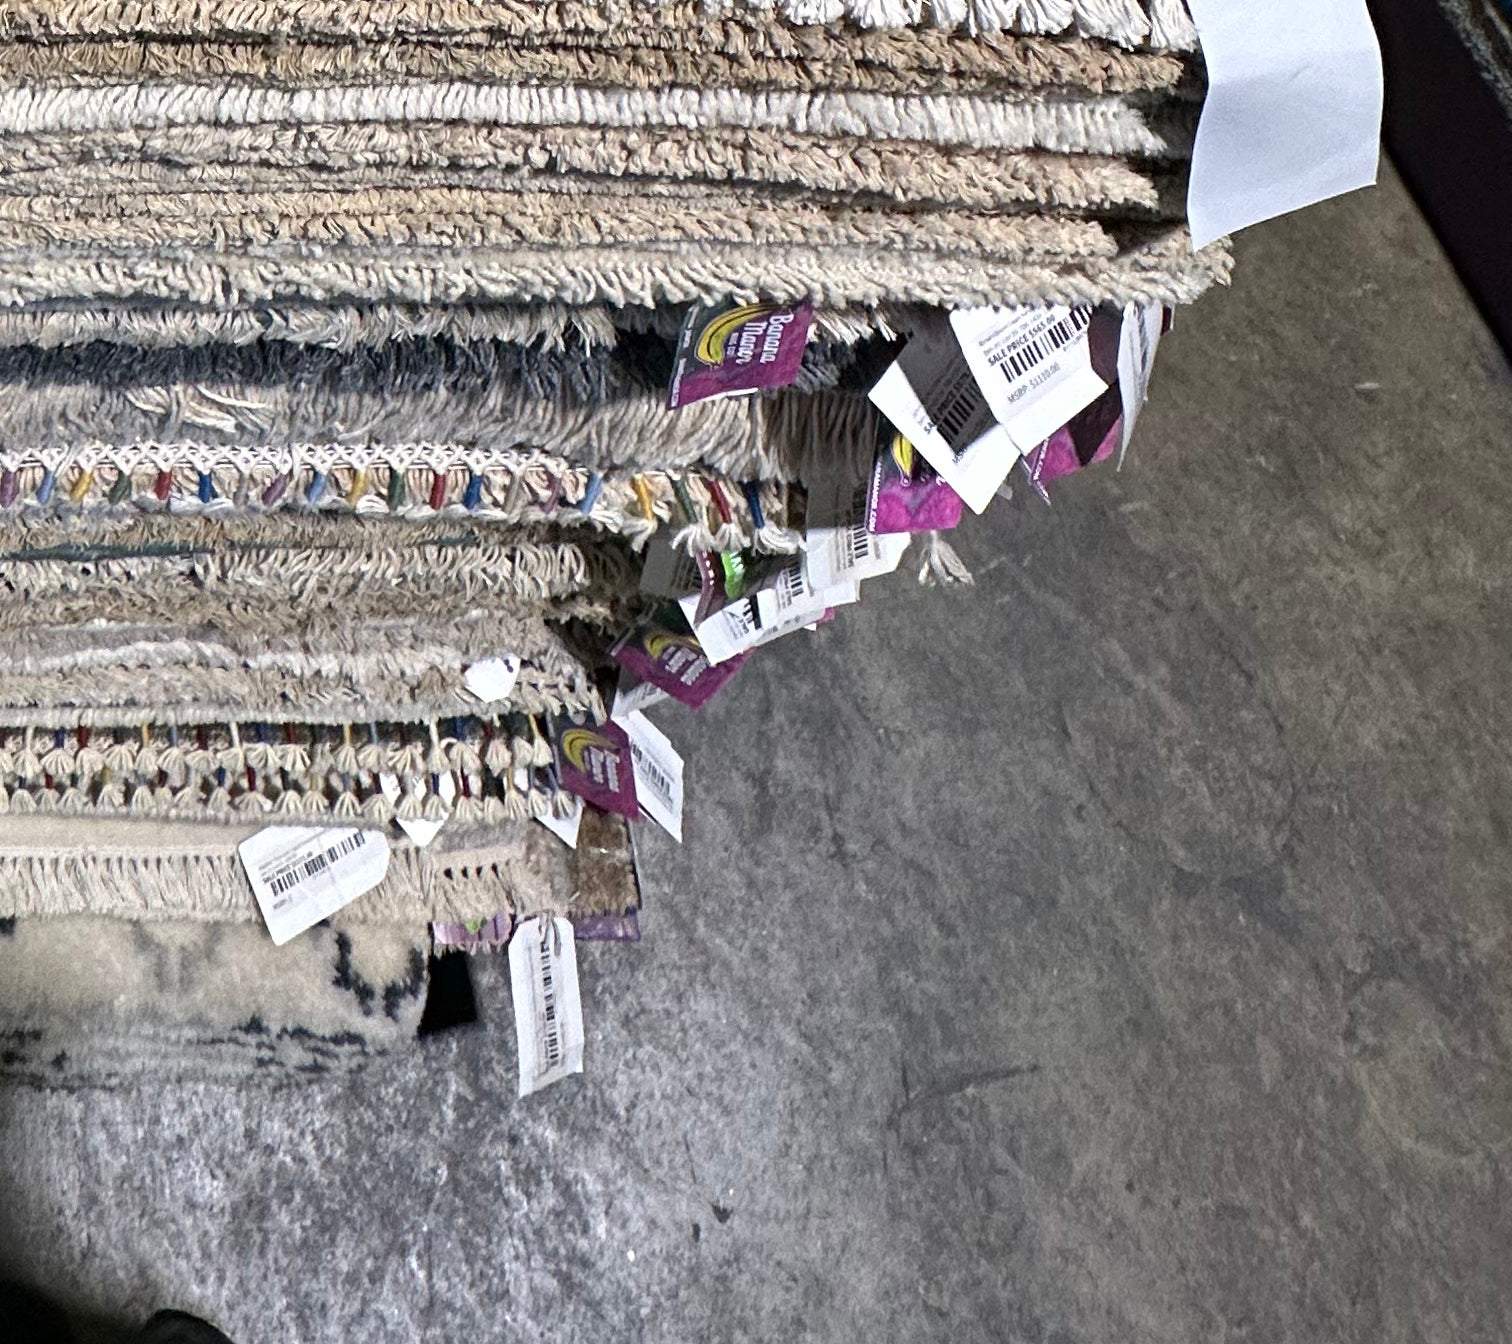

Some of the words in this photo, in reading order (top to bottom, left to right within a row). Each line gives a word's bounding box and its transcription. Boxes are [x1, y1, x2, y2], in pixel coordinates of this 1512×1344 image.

[736, 320, 769, 365] Manor
[759, 312, 795, 364] Banana
[988, 348, 1008, 367] SALE
[1006, 332, 1029, 354] PRICE
